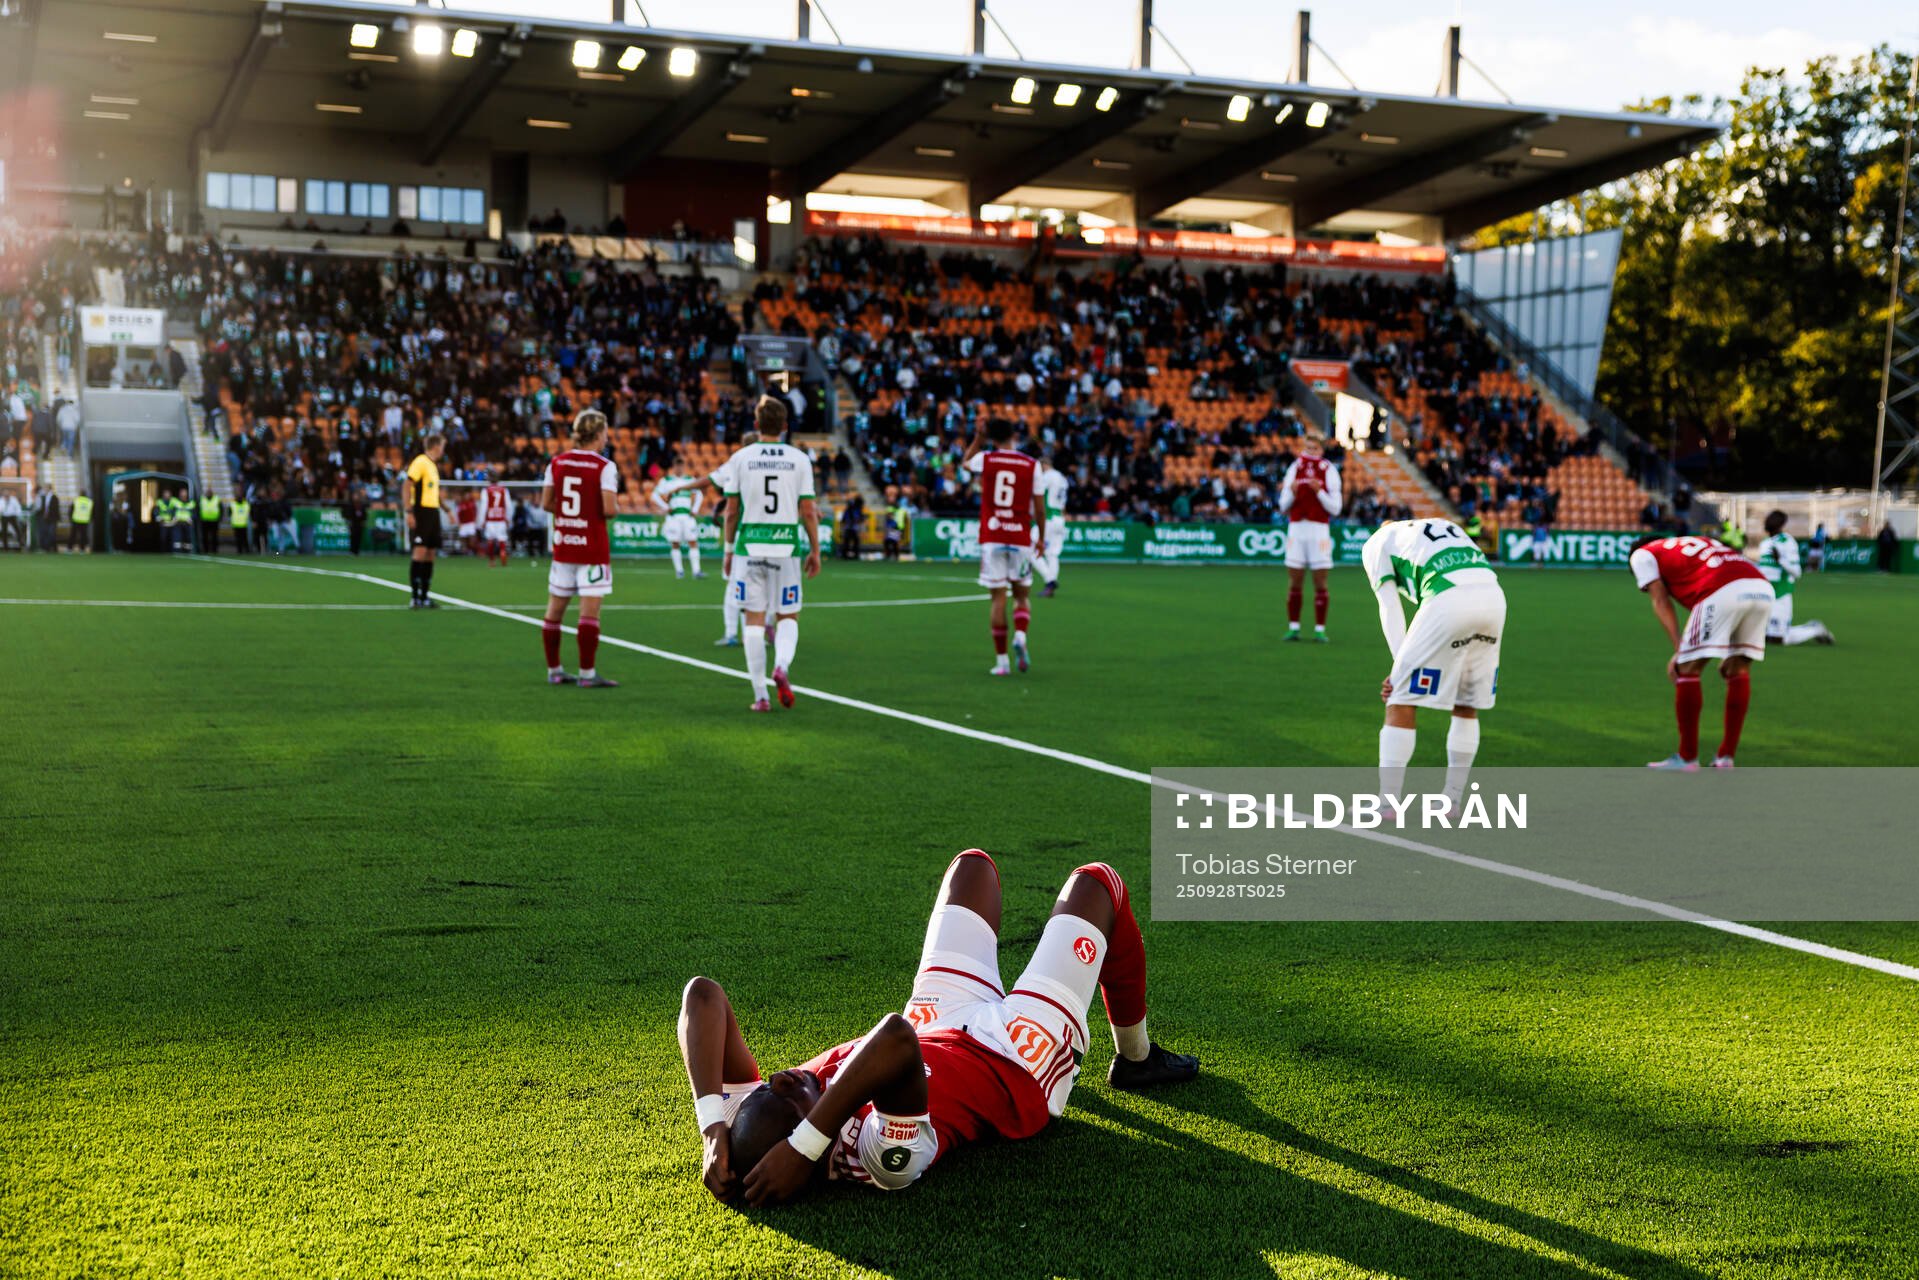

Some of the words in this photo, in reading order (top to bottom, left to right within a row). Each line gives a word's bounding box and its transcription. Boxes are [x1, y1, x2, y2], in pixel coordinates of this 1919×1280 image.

[562, 476, 582, 516] 5
[764, 476, 778, 514] 5
[994, 470, 1016, 507] 6
[613, 521, 659, 537] SKYLT
[880, 1126, 920, 1141] UNIBET
[890, 1153, 904, 1166] S
